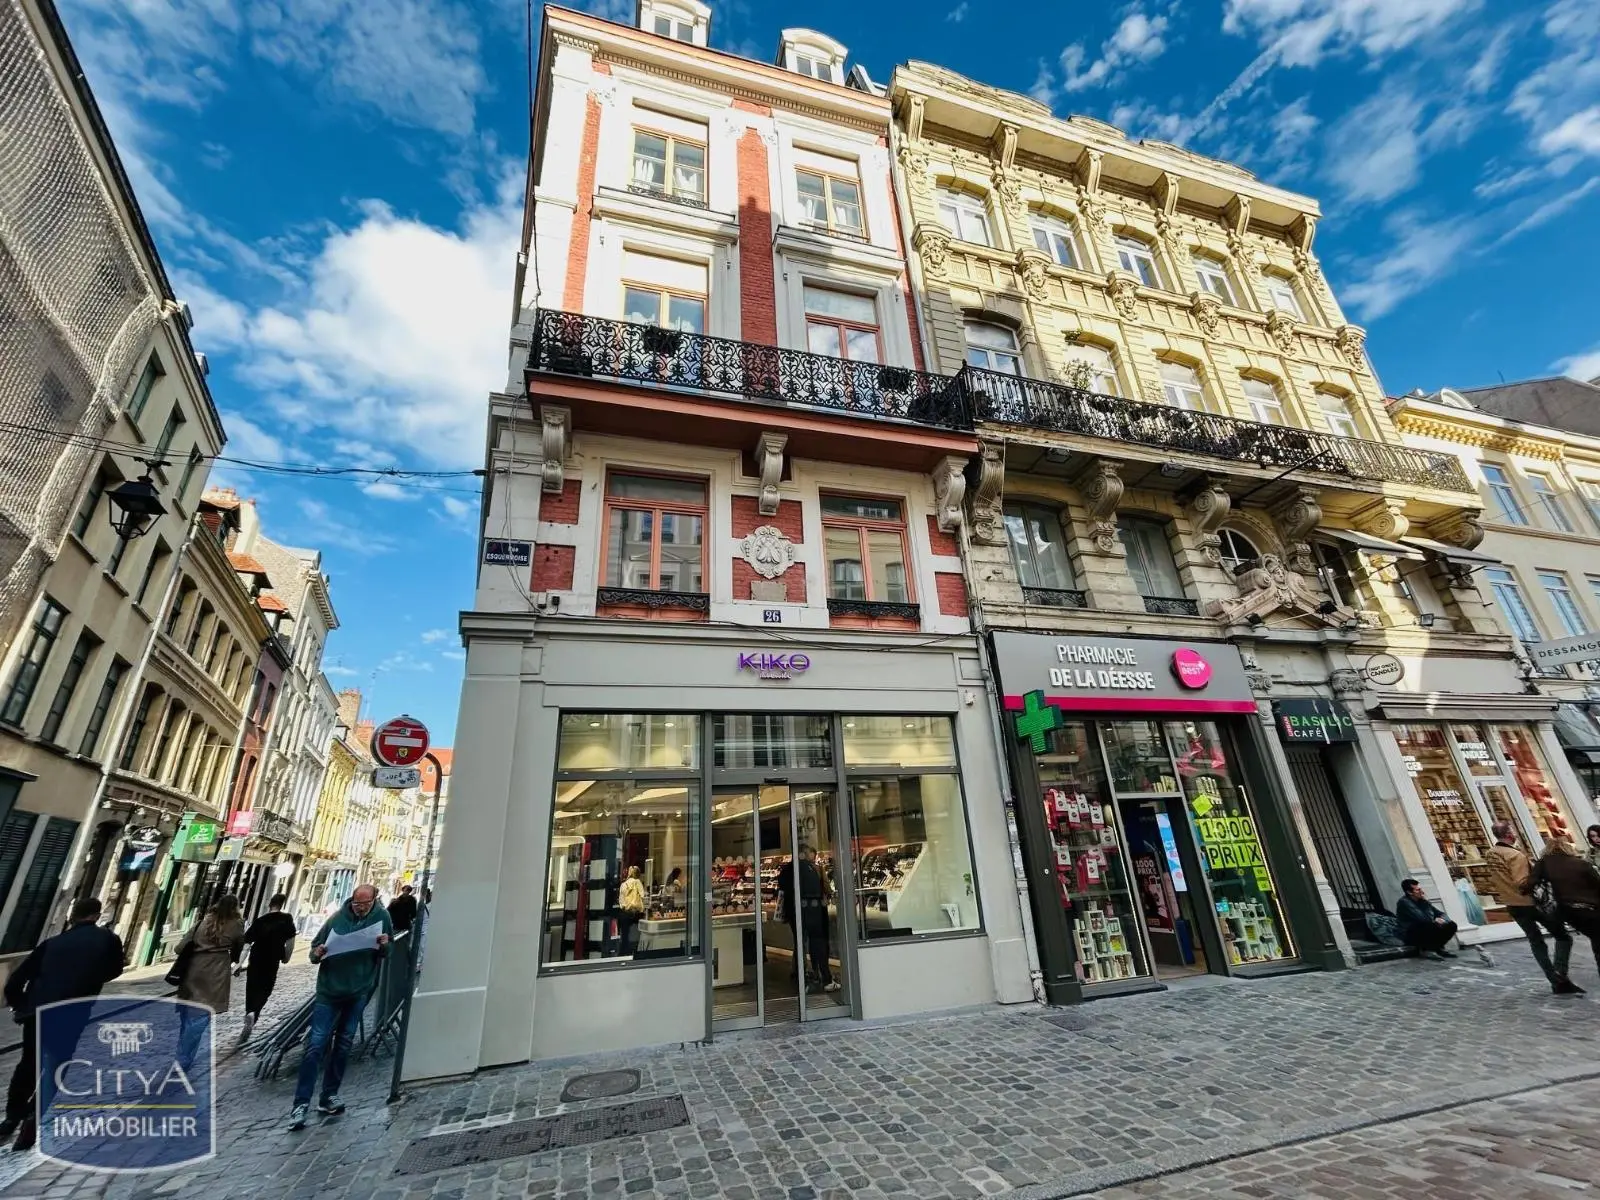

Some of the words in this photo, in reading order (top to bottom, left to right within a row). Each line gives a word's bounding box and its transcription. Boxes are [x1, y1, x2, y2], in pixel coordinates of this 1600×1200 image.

[765, 610, 780, 622] 26
[738, 652, 811, 671] KIKO
[1056, 644, 1138, 665] PHARMACIE
[1048, 668, 1073, 687] DE
[1074, 669, 1097, 688] LA
[1097, 666, 1156, 689] DÉESSE
[1370, 666, 1399, 677] CANDLES
[1293, 727, 1323, 738] CAFÉ
[1208, 845, 1262, 865] PRIX
